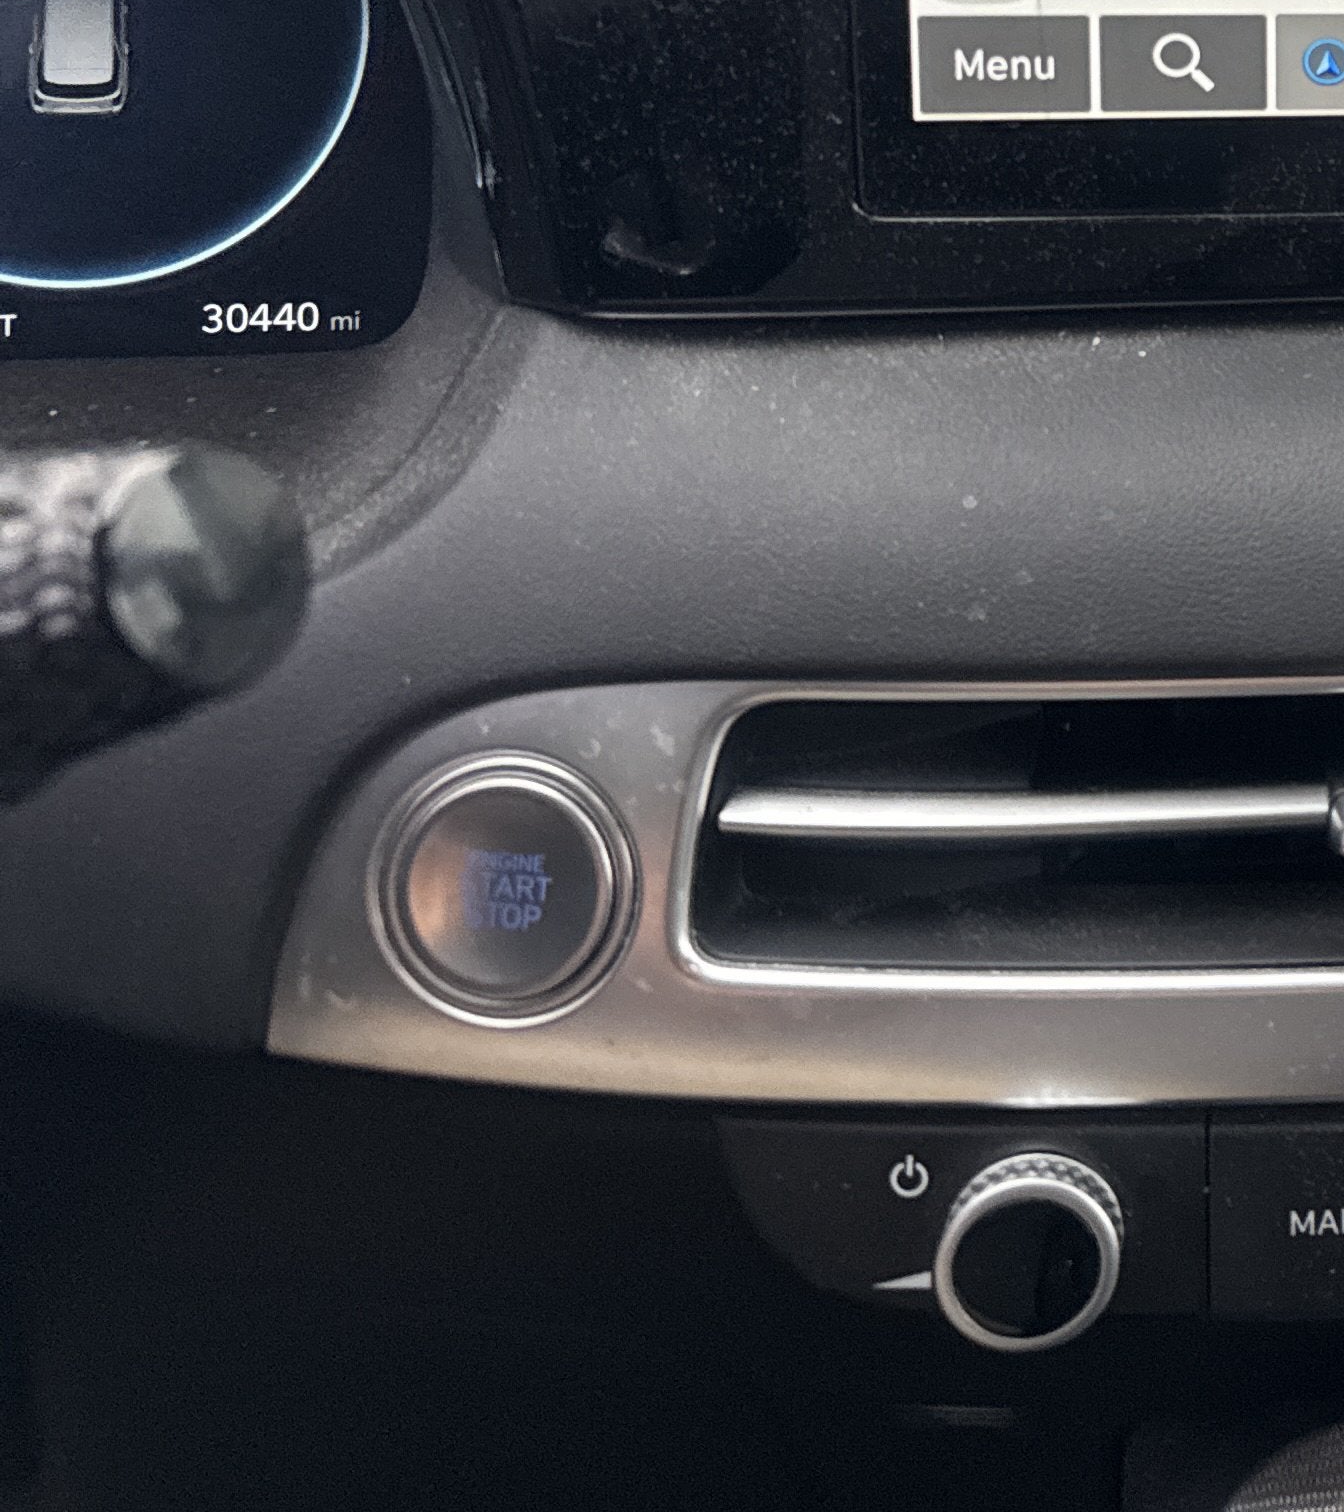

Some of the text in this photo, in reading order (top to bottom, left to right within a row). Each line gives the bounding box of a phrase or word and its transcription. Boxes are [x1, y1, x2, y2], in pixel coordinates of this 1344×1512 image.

[955, 48, 1055, 81] Menu
[201, 301, 360, 334] 30440 mi
